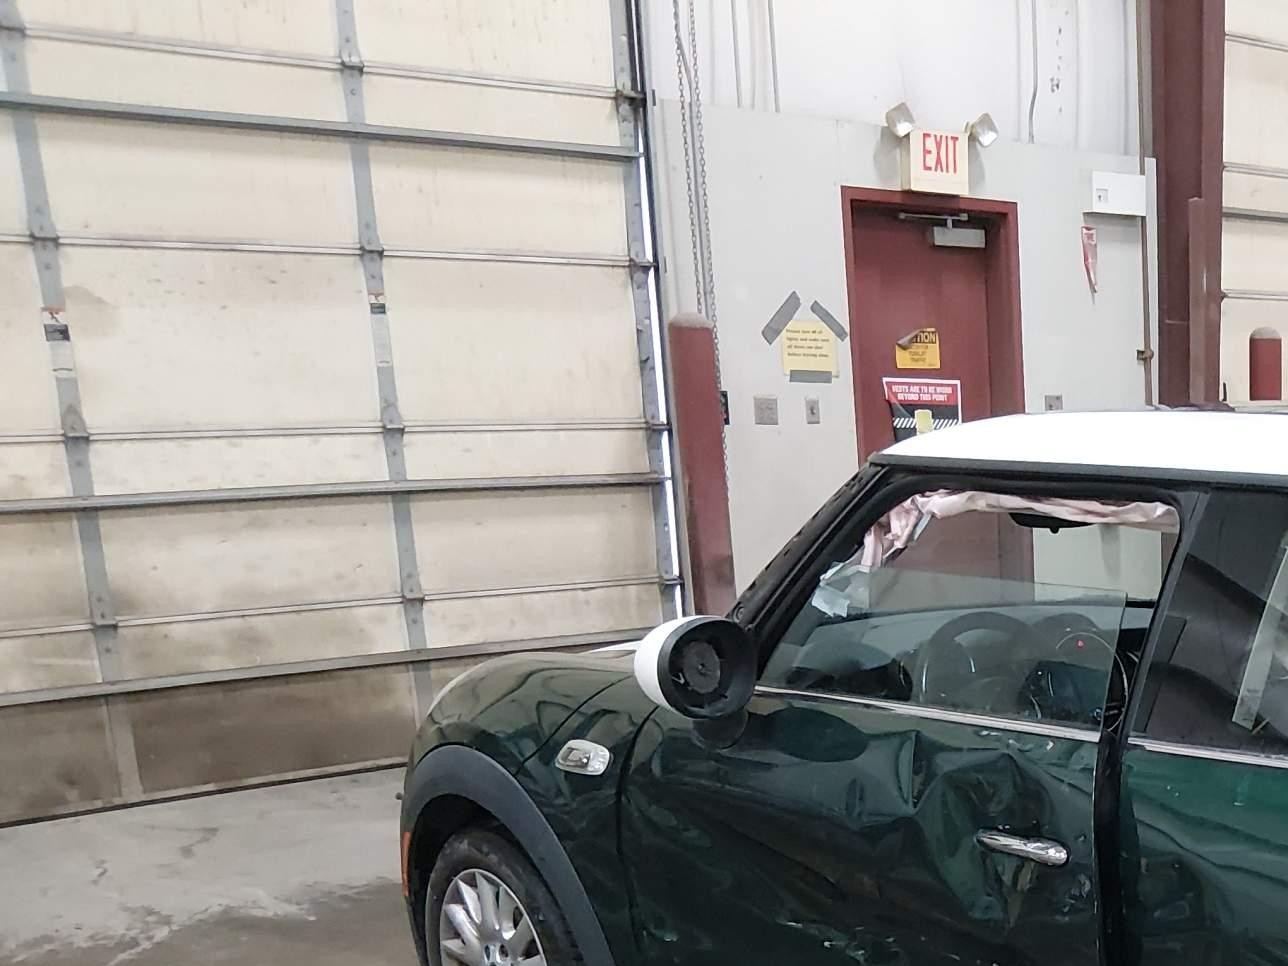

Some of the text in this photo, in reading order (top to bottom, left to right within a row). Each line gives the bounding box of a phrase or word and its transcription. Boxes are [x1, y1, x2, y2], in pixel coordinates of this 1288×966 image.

[922, 132, 960, 174] EXIT
[909, 385, 919, 393] ARE
[897, 393, 919, 401] BEYOND
[920, 393, 932, 401] THIS
